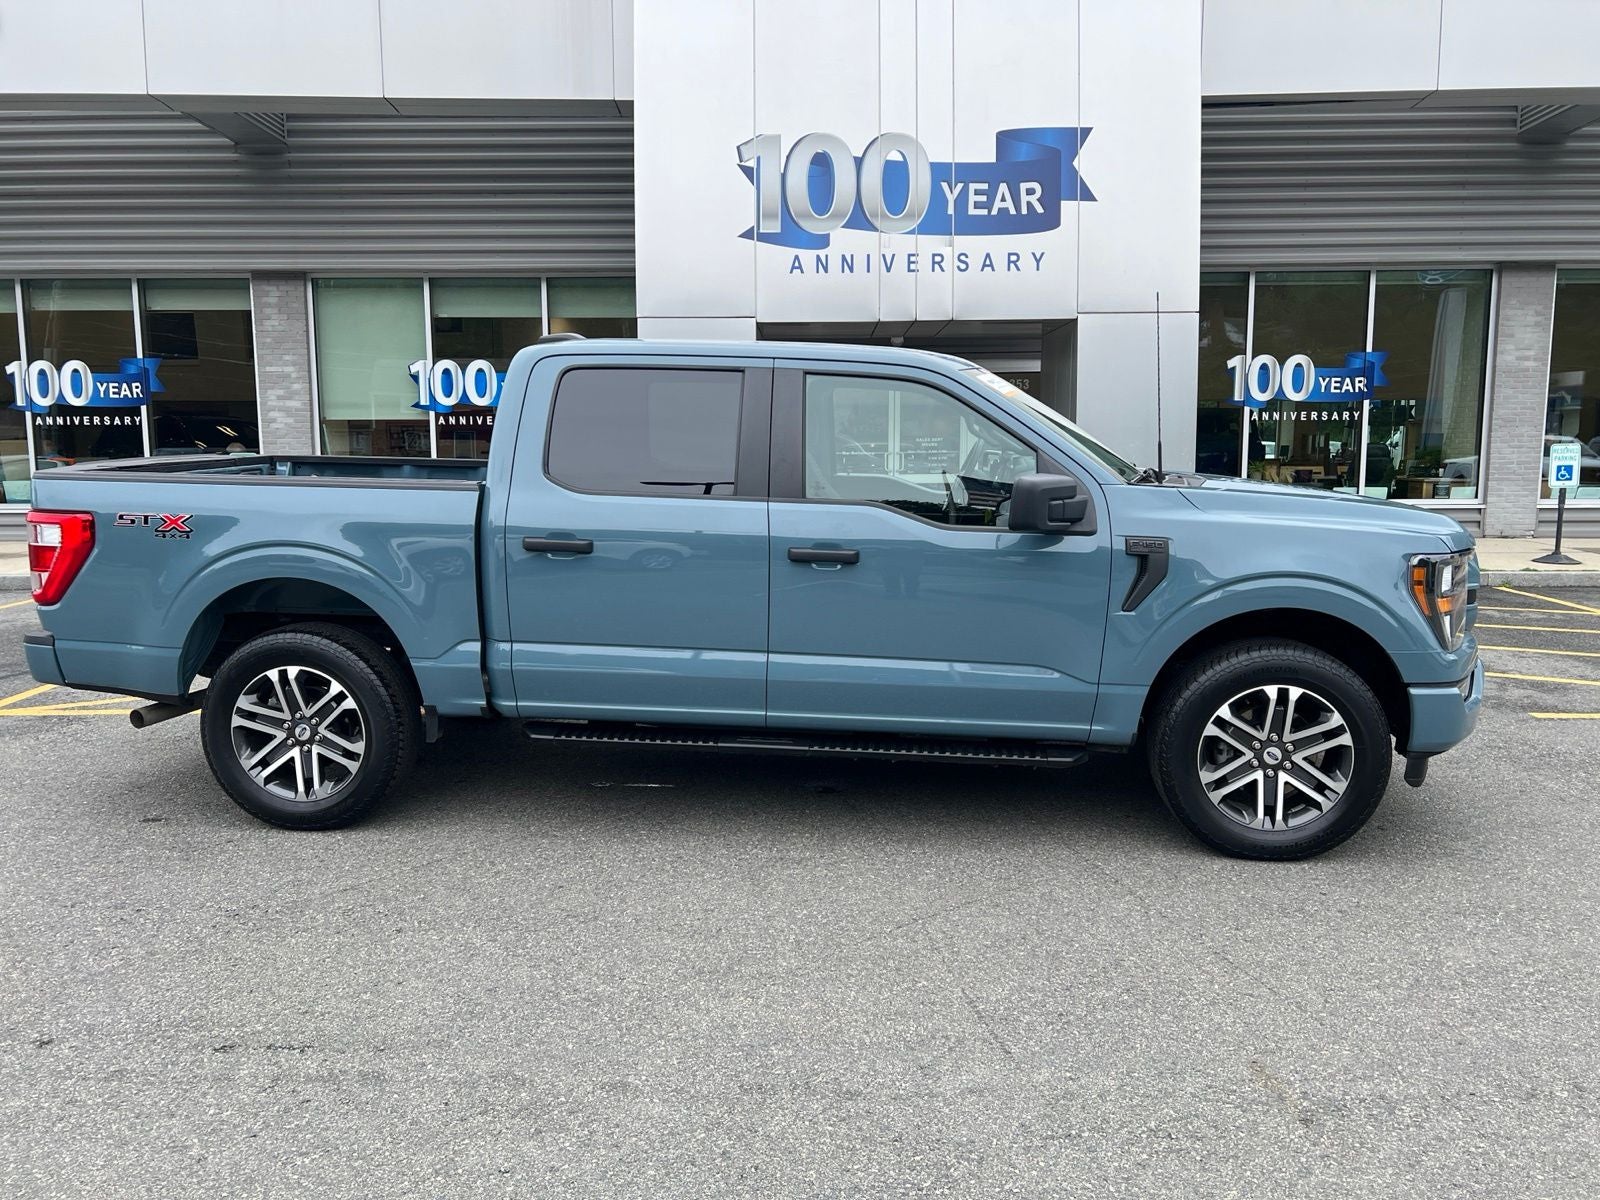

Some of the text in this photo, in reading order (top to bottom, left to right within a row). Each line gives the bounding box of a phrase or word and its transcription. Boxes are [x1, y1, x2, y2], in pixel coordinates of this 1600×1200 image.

[736, 132, 1045, 234] 100 YEAR
[790, 252, 1046, 274] ANNIVERSARY
[5, 360, 143, 406] 100 YEAR
[408, 359, 497, 406] 100
[1227, 354, 1367, 401] 100 YEAR
[36, 416, 141, 425] ANNIVERSARY
[438, 416, 493, 425] ANNIVE
[1251, 411, 1360, 421] ANNIVERSARY
[113, 512, 193, 533] STX
[1130, 540, 1165, 549] F-150
